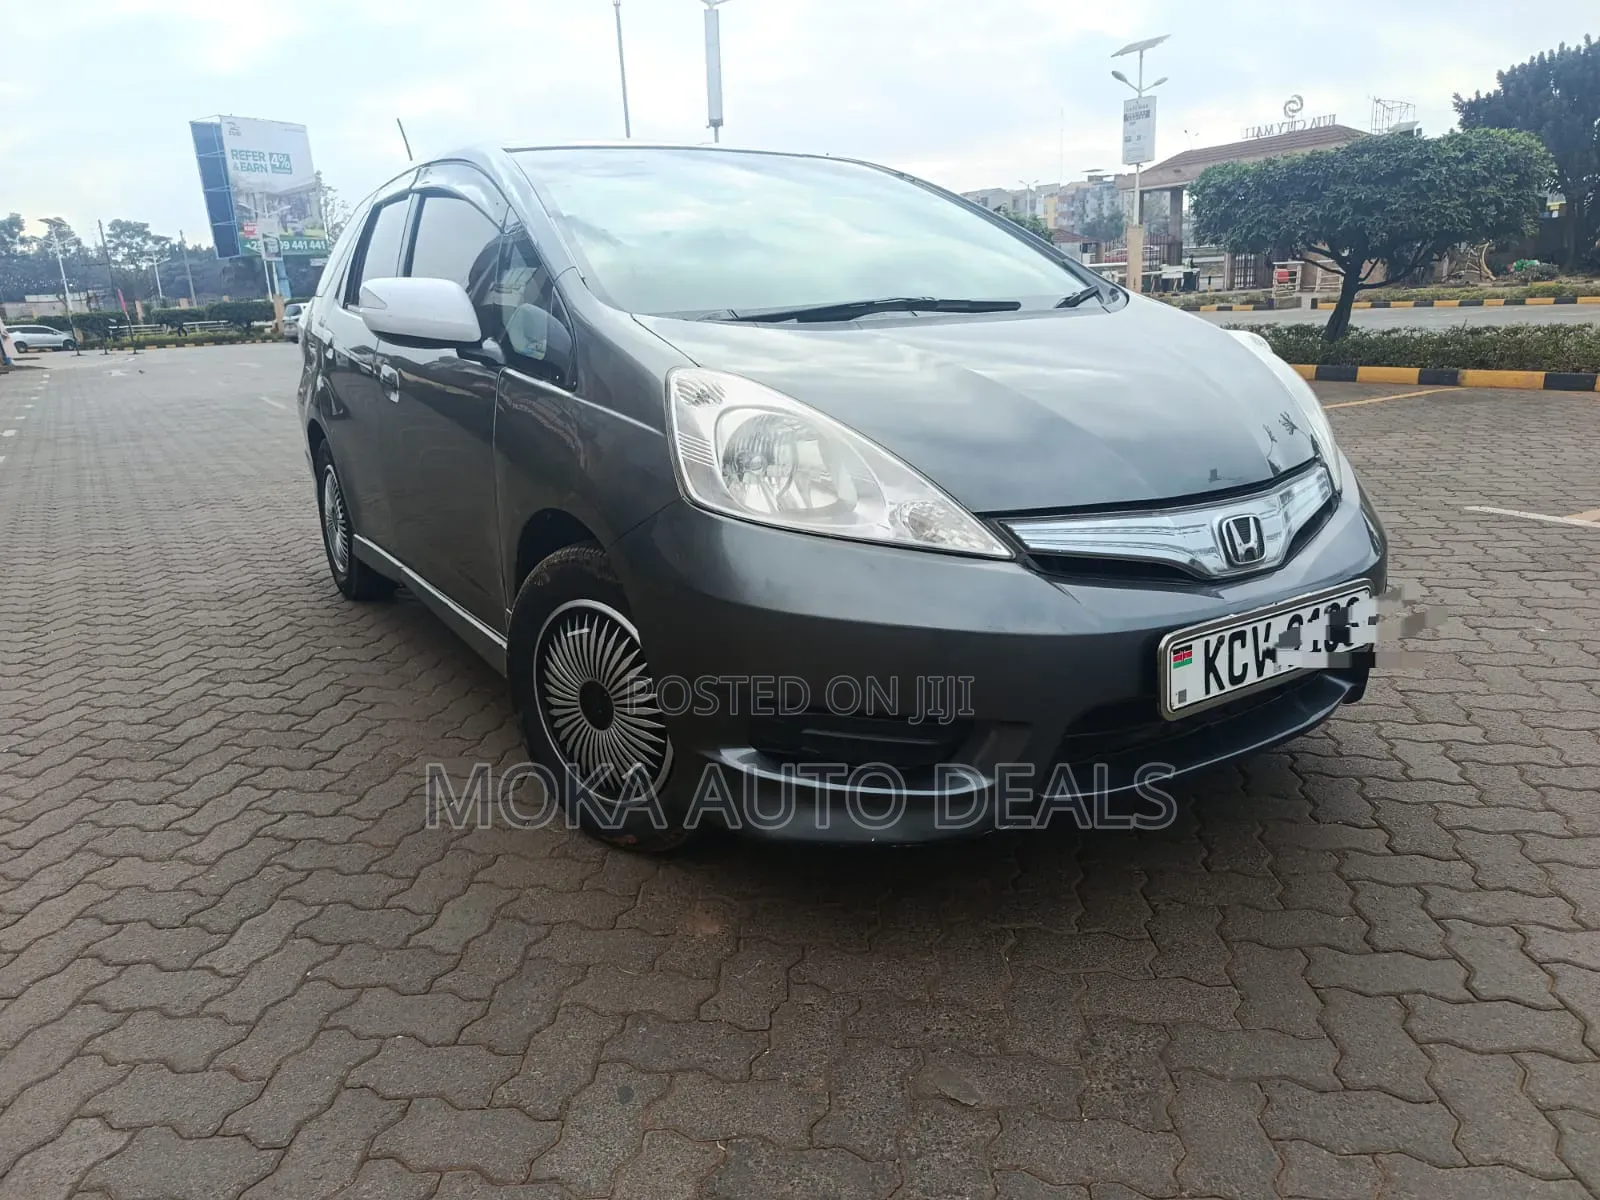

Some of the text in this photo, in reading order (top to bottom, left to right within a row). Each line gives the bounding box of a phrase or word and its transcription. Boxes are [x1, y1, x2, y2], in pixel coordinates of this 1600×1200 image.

[231, 149, 266, 162] REFER
[271, 153, 291, 169] 4%
[292, 241, 308, 250] 441
[309, 240, 326, 250] 441
